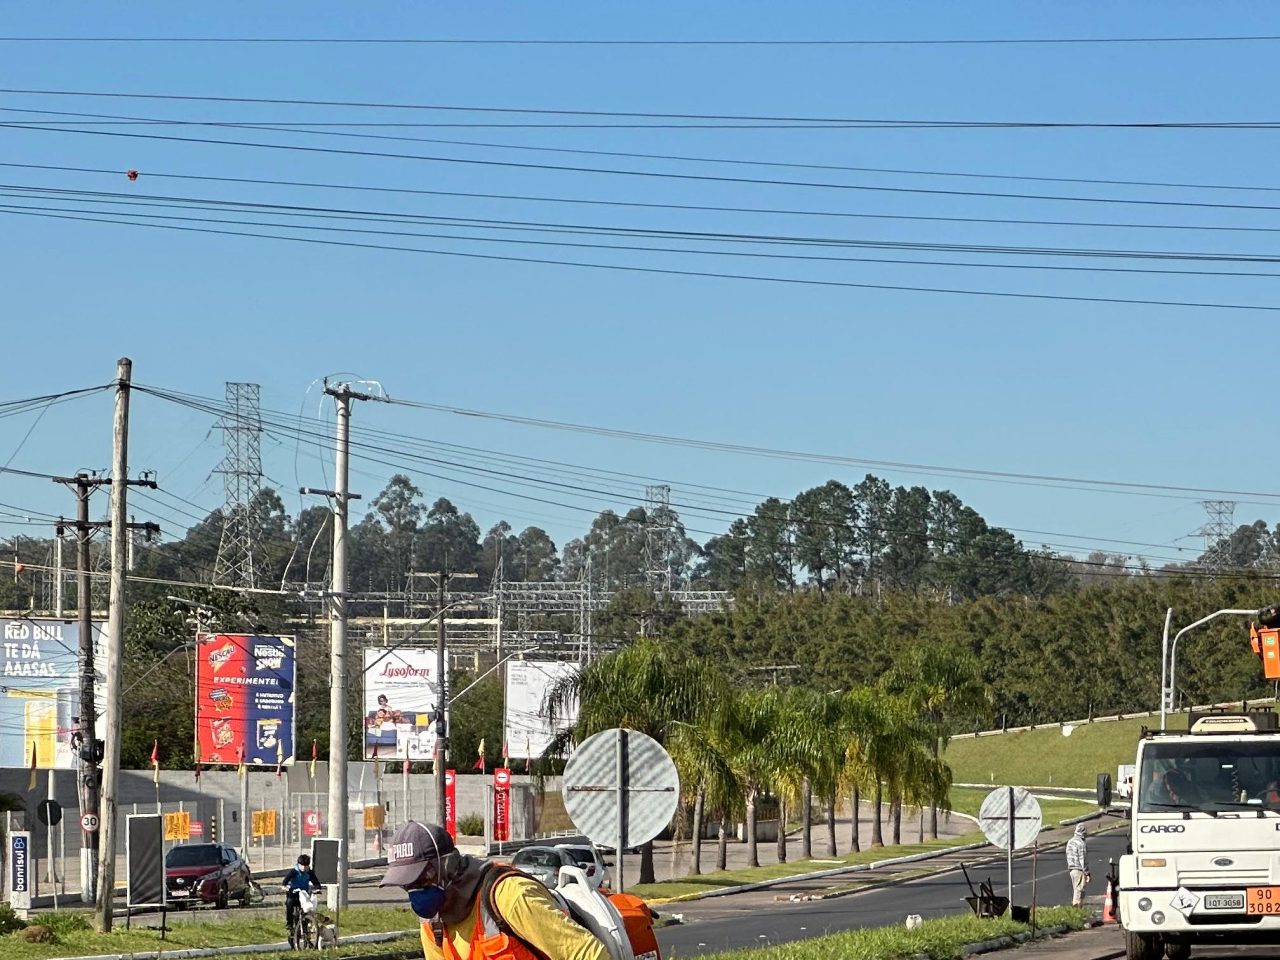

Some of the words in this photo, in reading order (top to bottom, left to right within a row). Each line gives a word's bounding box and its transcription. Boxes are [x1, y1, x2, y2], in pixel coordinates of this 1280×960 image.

[5, 622, 30, 639] RED
[33, 625, 63, 640] BULL
[4, 642, 19, 658] TE
[22, 641, 40, 658] DÁ
[209, 645, 235, 664] NESCAU
[380, 662, 430, 678] Lysoform
[84, 817, 97, 826] 30
[1140, 824, 1186, 834] CARGO
[15, 850, 24, 891] banrisul
[1257, 889, 1272, 900] 90
